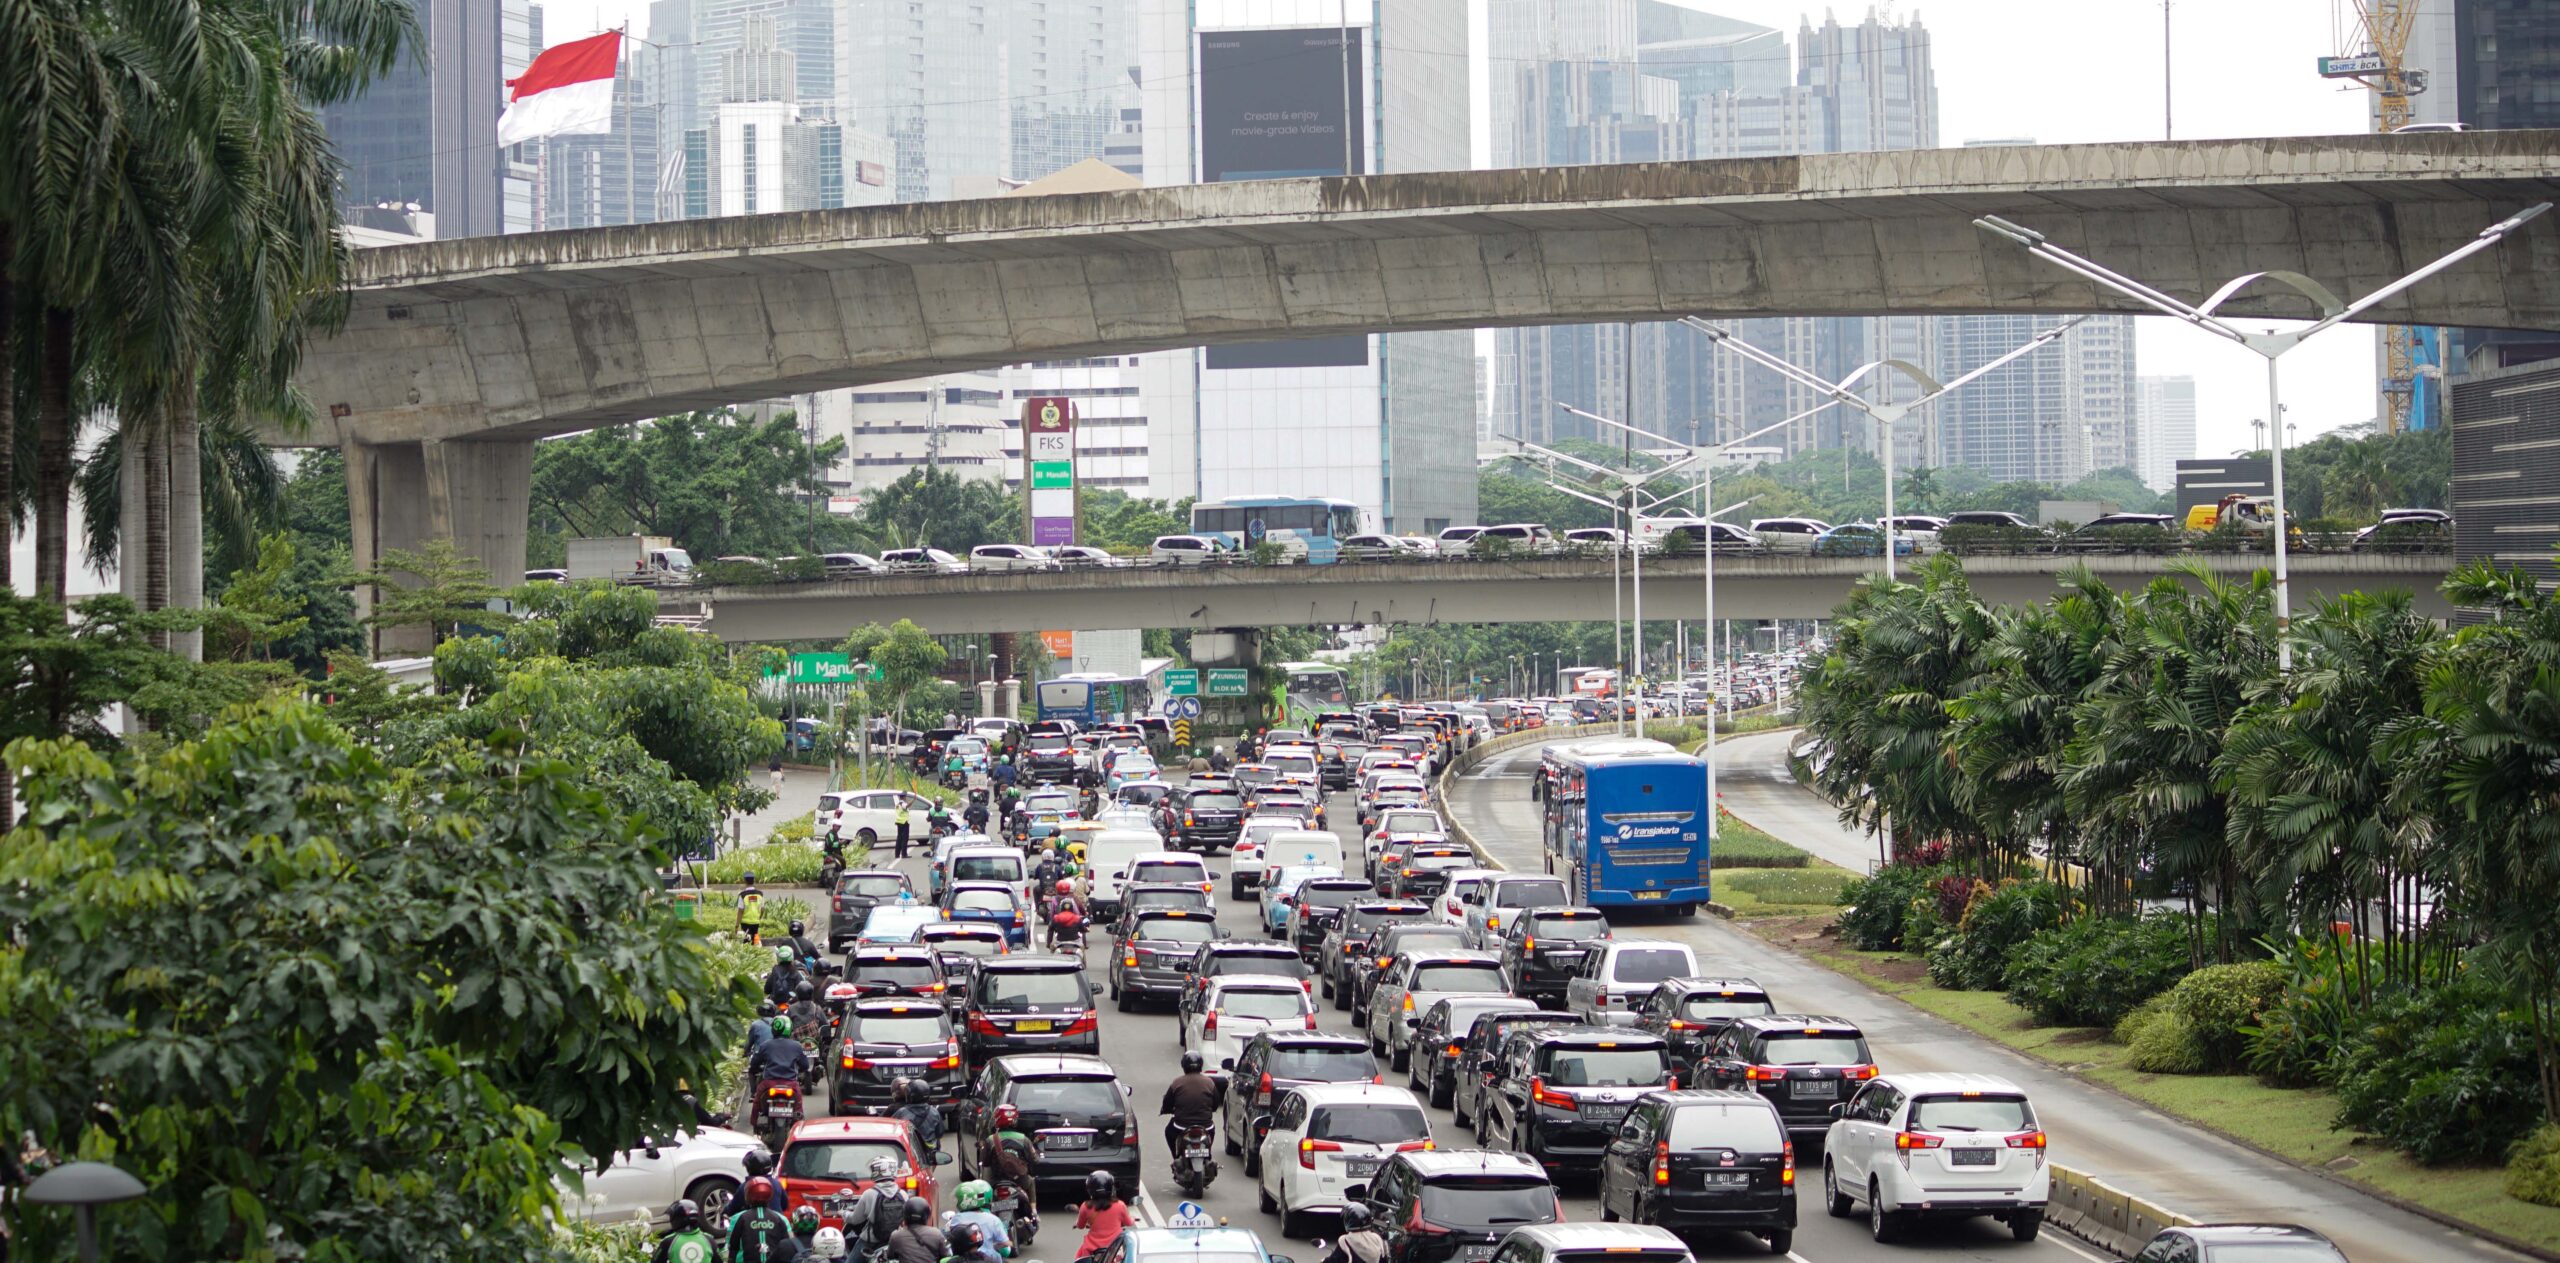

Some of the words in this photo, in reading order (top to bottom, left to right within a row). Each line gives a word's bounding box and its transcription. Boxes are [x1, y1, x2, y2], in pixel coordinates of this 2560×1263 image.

[1244, 111, 1279, 121] Create
[1281, 111, 1289, 120] &
[1291, 110, 1319, 122] enjoy
[1232, 125, 1298, 137] movie-grade
[1039, 437, 1064, 450] FKS
[1633, 826, 1680, 836] transjakarta
[750, 1220, 775, 1229] Grab
